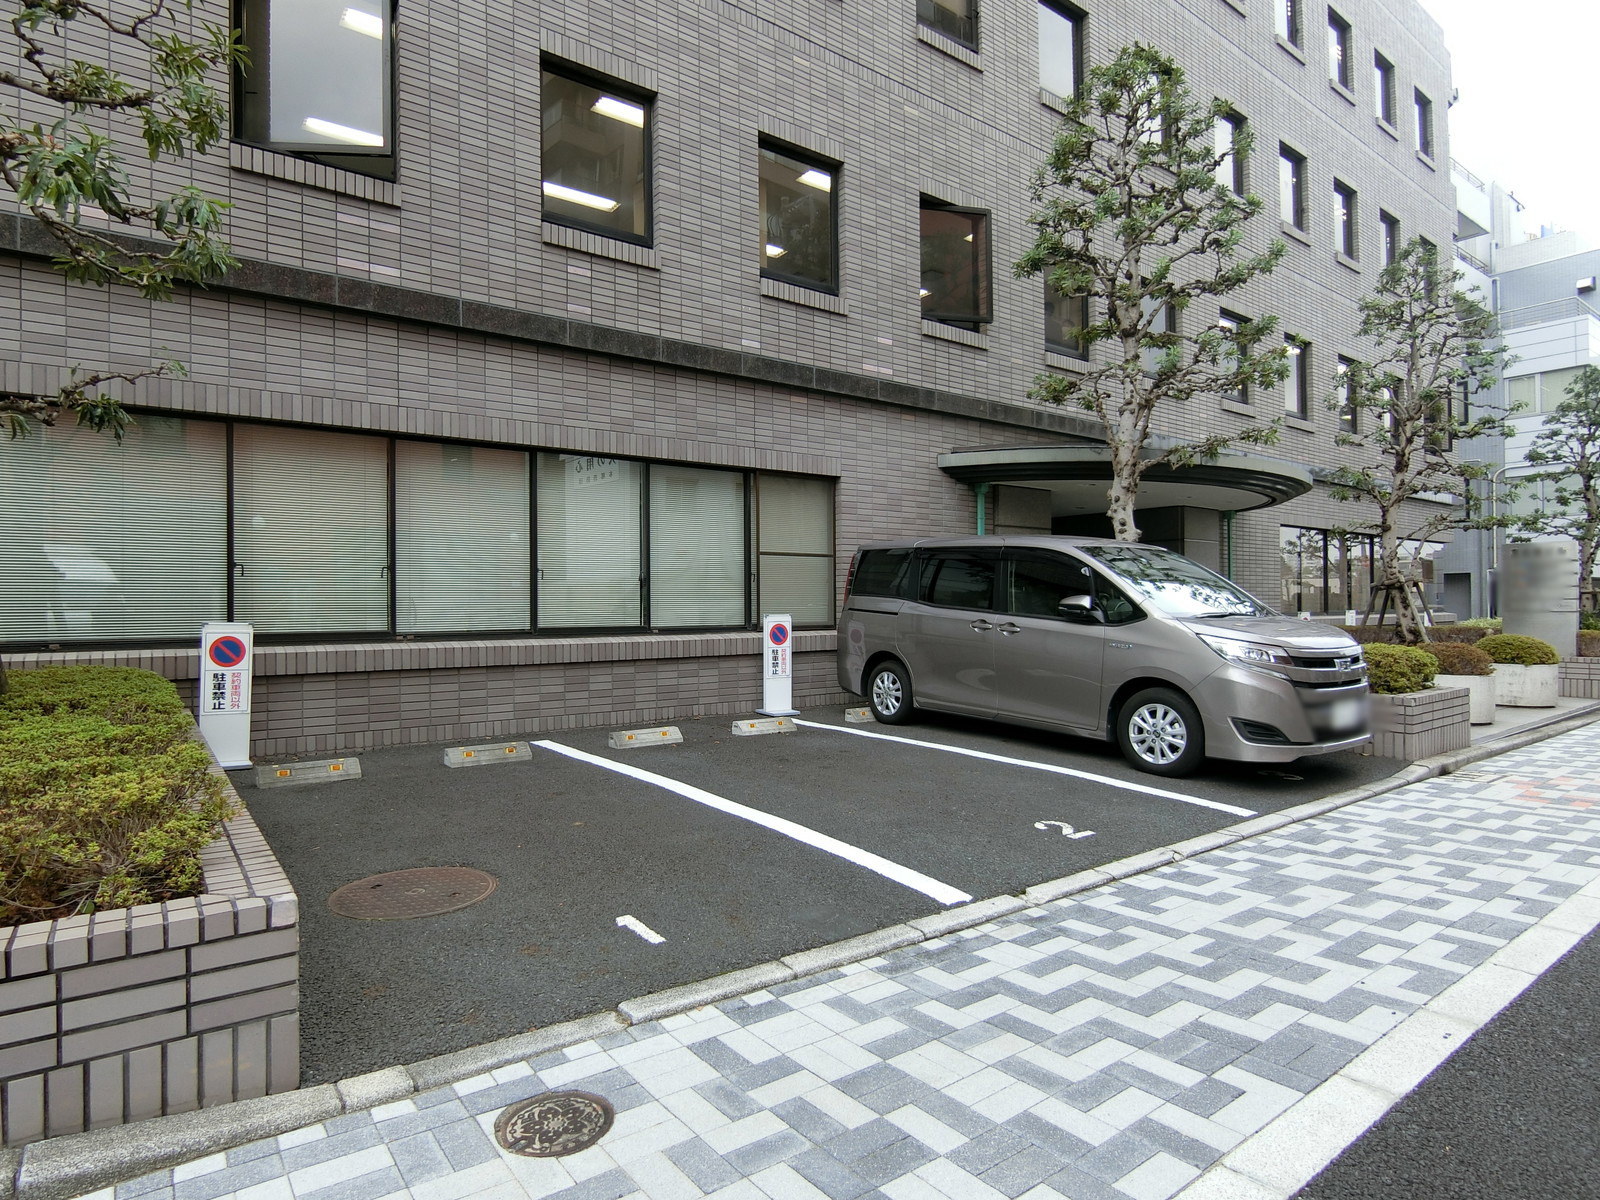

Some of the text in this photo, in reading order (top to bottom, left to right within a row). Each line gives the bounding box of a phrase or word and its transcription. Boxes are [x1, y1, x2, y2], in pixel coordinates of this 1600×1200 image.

[771, 649, 779, 675] 駐車禁止
[211, 672, 227, 710] 駐車禁止
[230, 672, 241, 710] 契約車両以外
[1034, 820, 1096, 839] 2
[615, 914, 667, 944] 1
